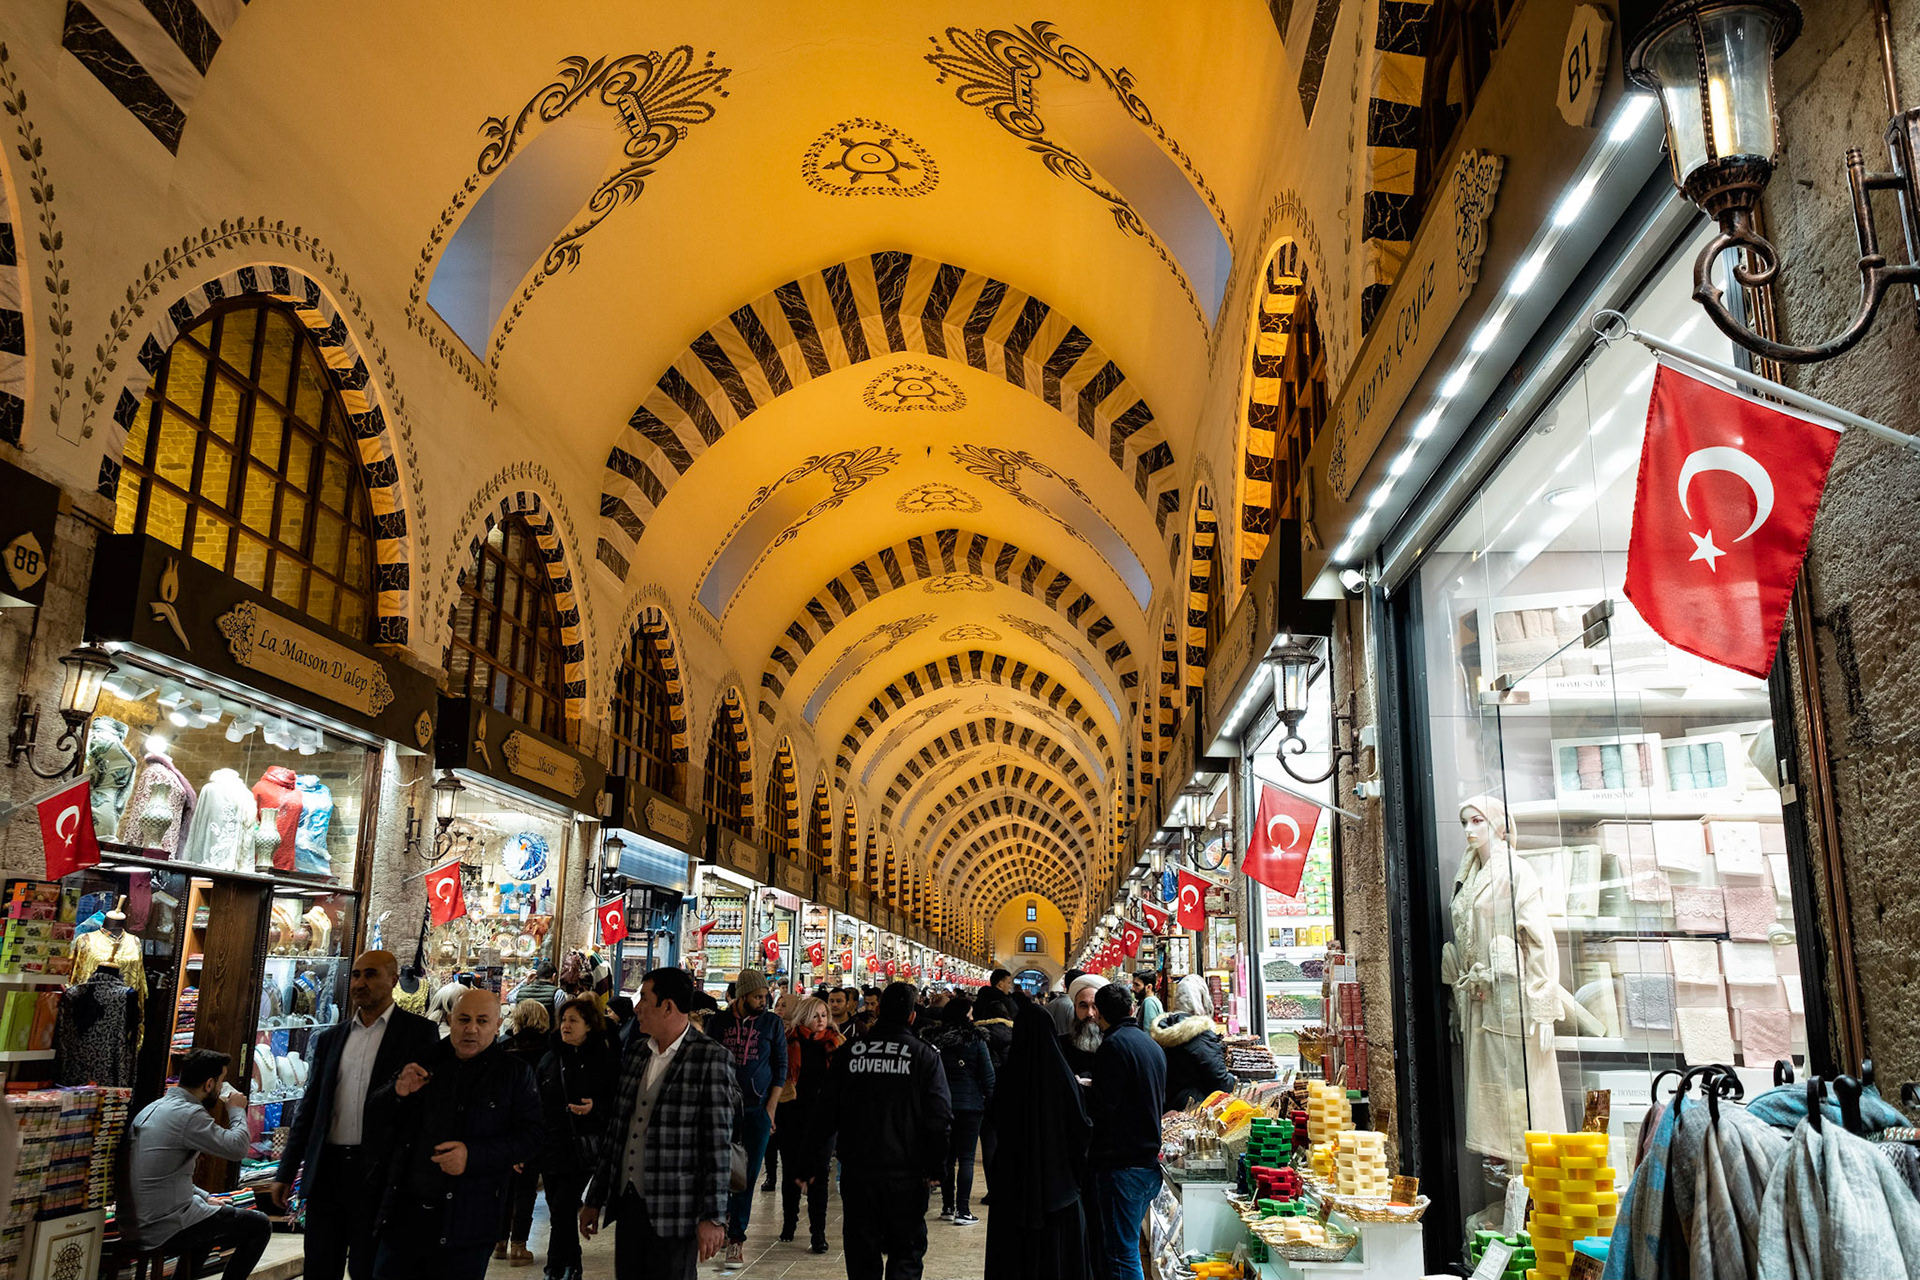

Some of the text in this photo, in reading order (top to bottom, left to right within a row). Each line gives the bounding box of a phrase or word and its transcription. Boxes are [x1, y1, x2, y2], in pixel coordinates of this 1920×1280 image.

[1568, 26, 1591, 104] 81
[1355, 259, 1435, 436] Merve Çeyiz
[14, 545, 39, 575] 88
[258, 629, 277, 652] La
[331, 660, 368, 695] D'alep
[1556, 679, 1606, 689] HOMESTAR
[420, 719, 430, 737] 86
[1592, 791, 1634, 800] HOMESTAR
[851, 1040, 912, 1058] ÖZEL
[849, 1056, 911, 1075] GÜVENLİK
[1618, 1089, 1654, 1097] HOMESTA
